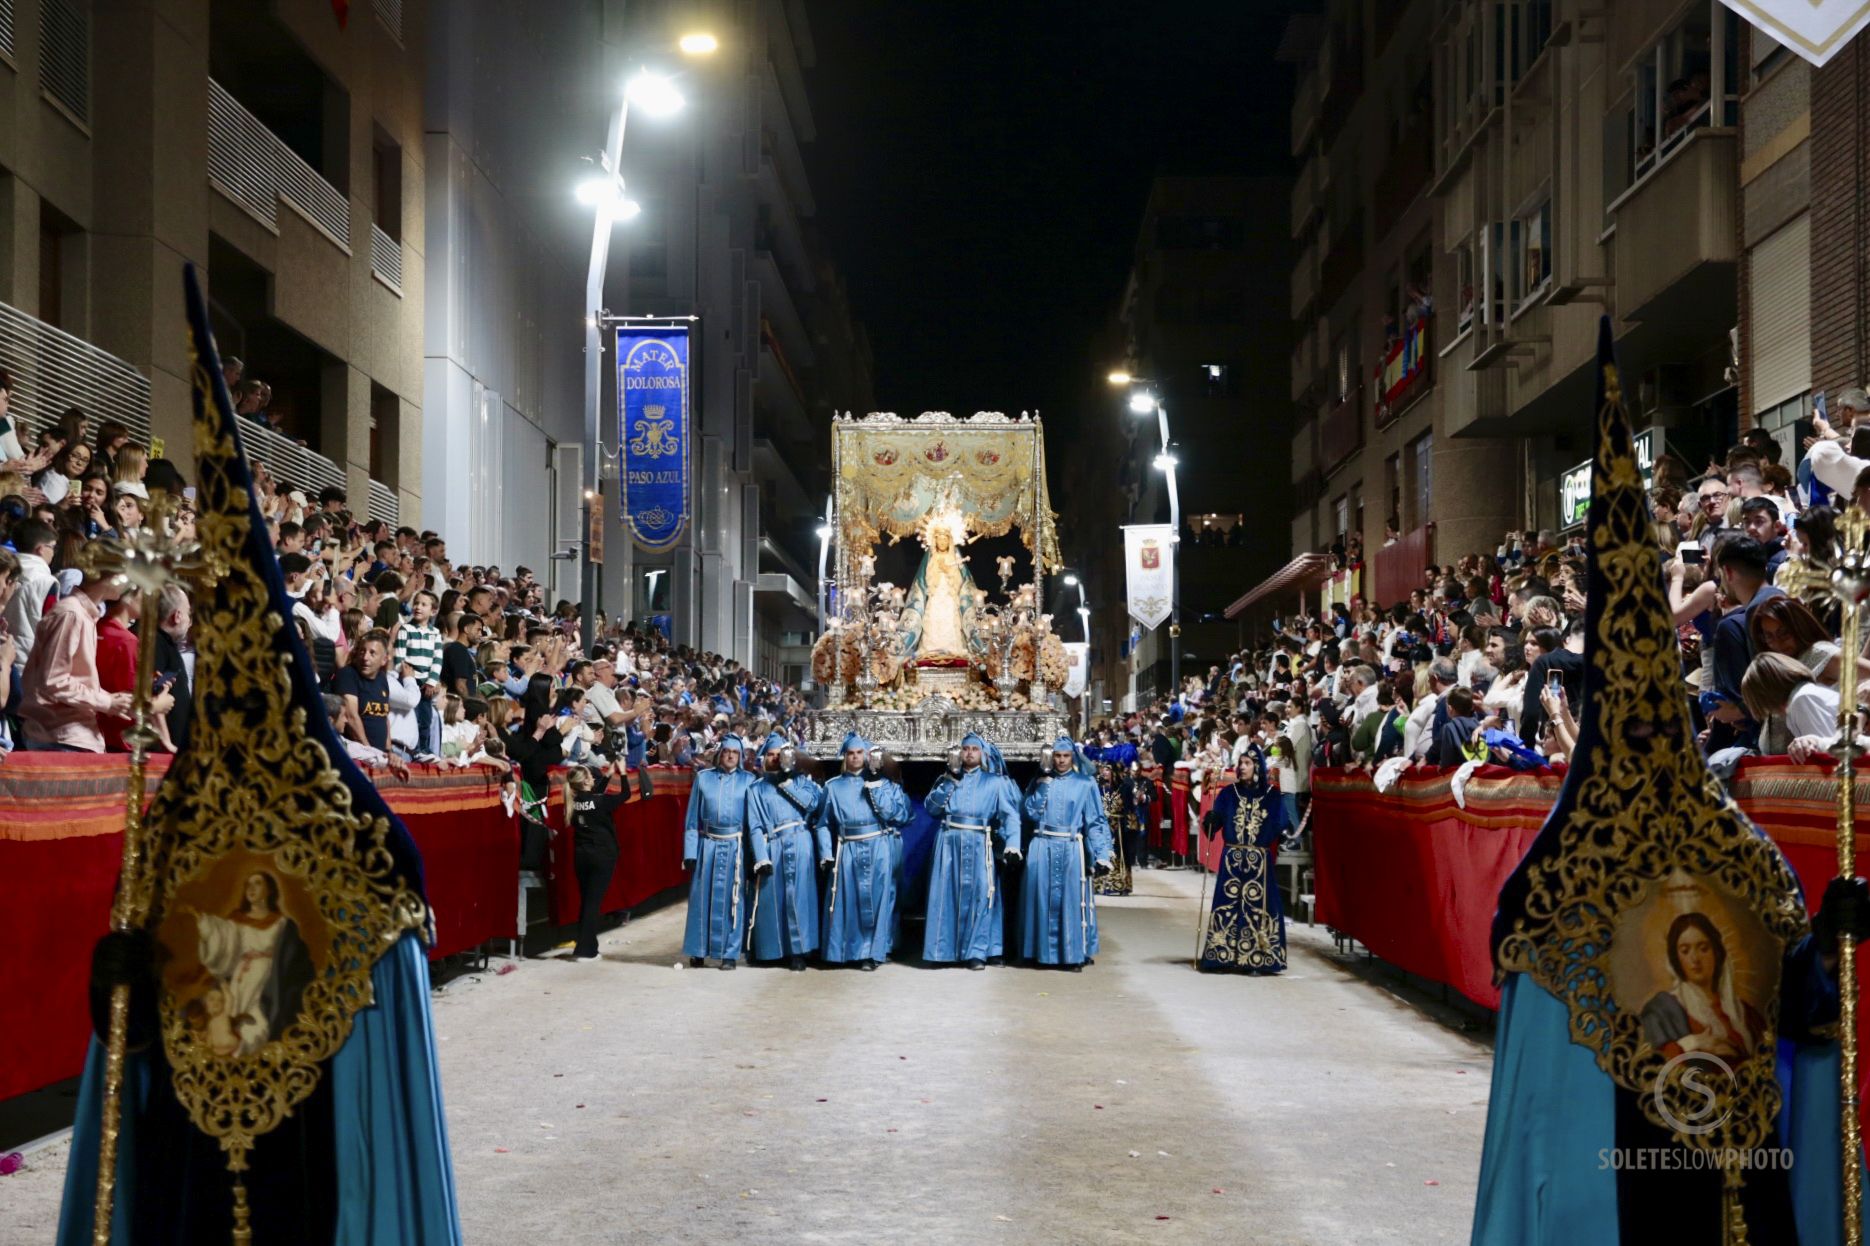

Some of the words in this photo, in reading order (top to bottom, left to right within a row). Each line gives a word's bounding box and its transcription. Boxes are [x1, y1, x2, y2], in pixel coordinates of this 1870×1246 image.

[630, 349, 675, 372] MATER
[626, 375, 681, 390] DOLOROSA
[628, 471, 654, 485] PASO
[655, 470, 681, 484] AZUL
